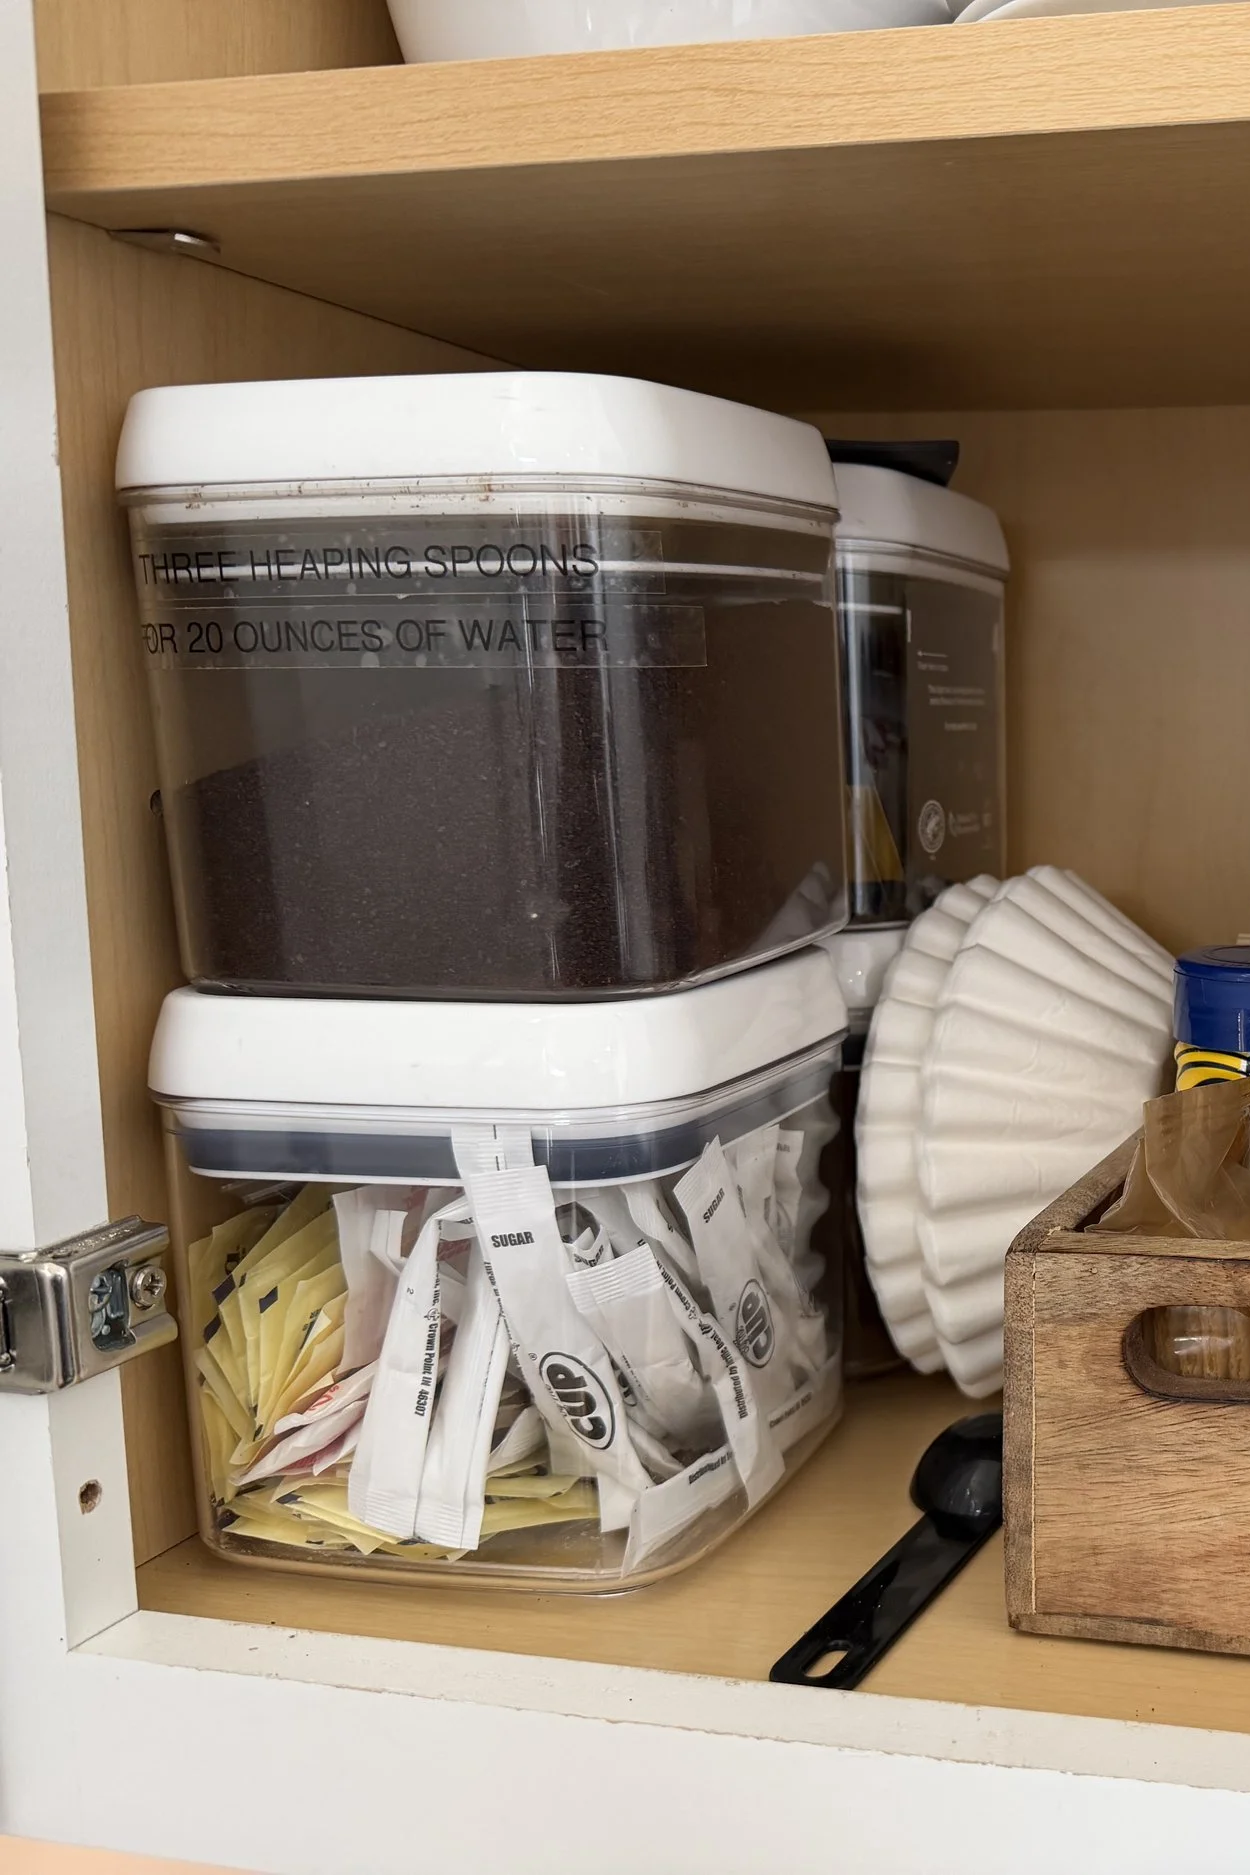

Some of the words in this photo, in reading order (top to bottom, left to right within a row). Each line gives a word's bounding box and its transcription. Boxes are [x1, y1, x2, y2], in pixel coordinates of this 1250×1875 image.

[139, 551, 239, 584] THREE
[250, 546, 412, 582] HEAPING
[424, 544, 600, 577] SPOONS
[187, 621, 224, 653] 20
[233, 619, 384, 654] OUNCES
[395, 619, 447, 651] OF
[458, 619, 609, 652] WATER
[702, 1187, 725, 1224] SUGAR
[491, 1231, 535, 1248] SUGAR
[425, 1322, 439, 1357] Crown
[420, 1375, 432, 1387] IN
[422, 1357, 435, 1376] Point
[414, 1389, 430, 1417] 46307
[546, 1363, 608, 1441] CUP
